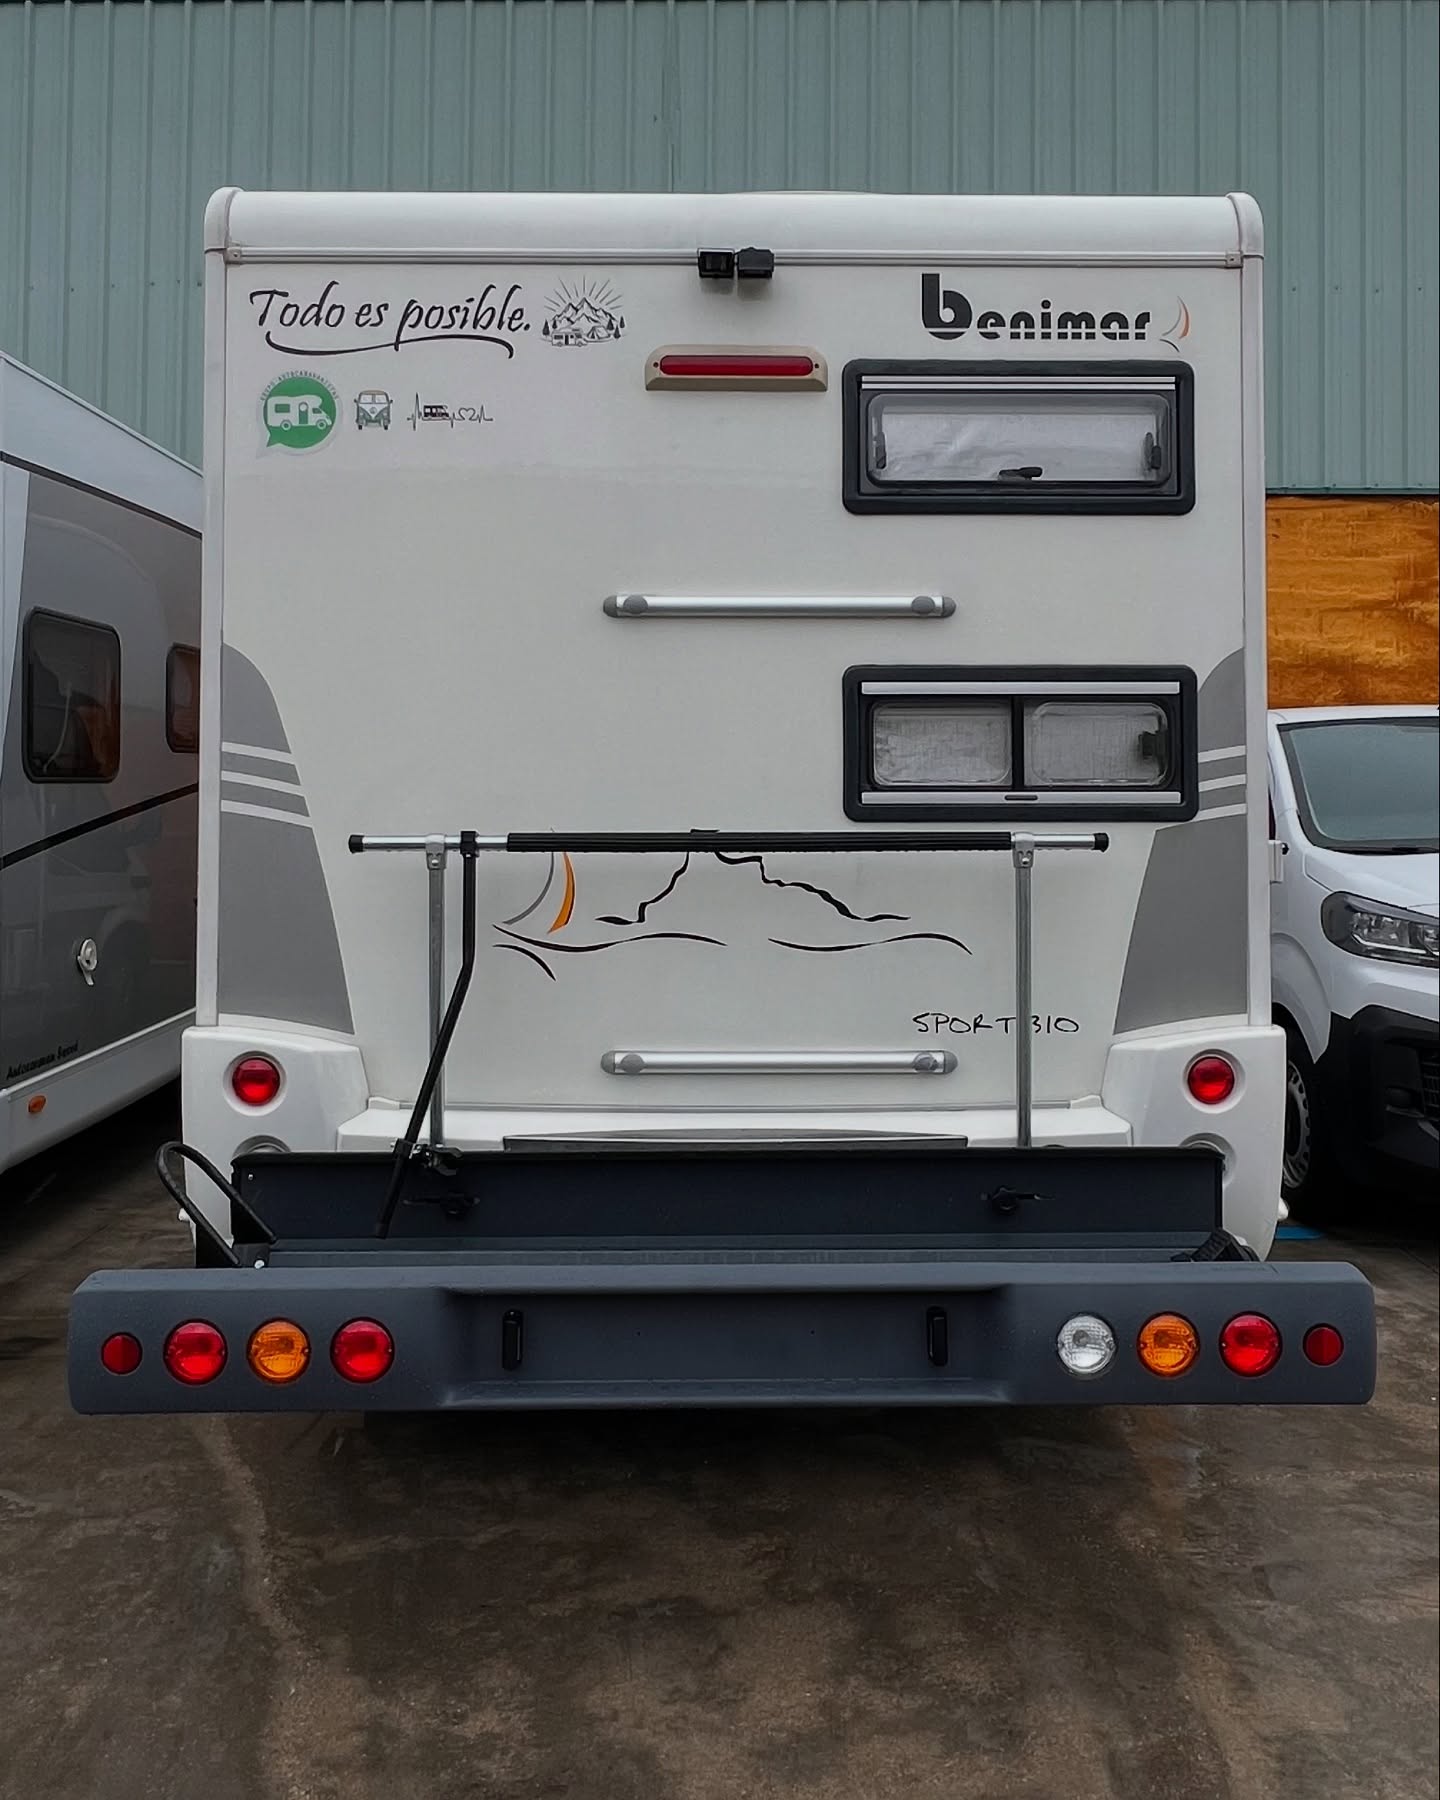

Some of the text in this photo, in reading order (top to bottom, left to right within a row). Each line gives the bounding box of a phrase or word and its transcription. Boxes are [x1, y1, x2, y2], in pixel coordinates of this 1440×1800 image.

[249, 280, 531, 351] Todo es posible.
[921, 272, 1151, 341] benimar
[912, 1012, 1080, 1034] SPORT 310
